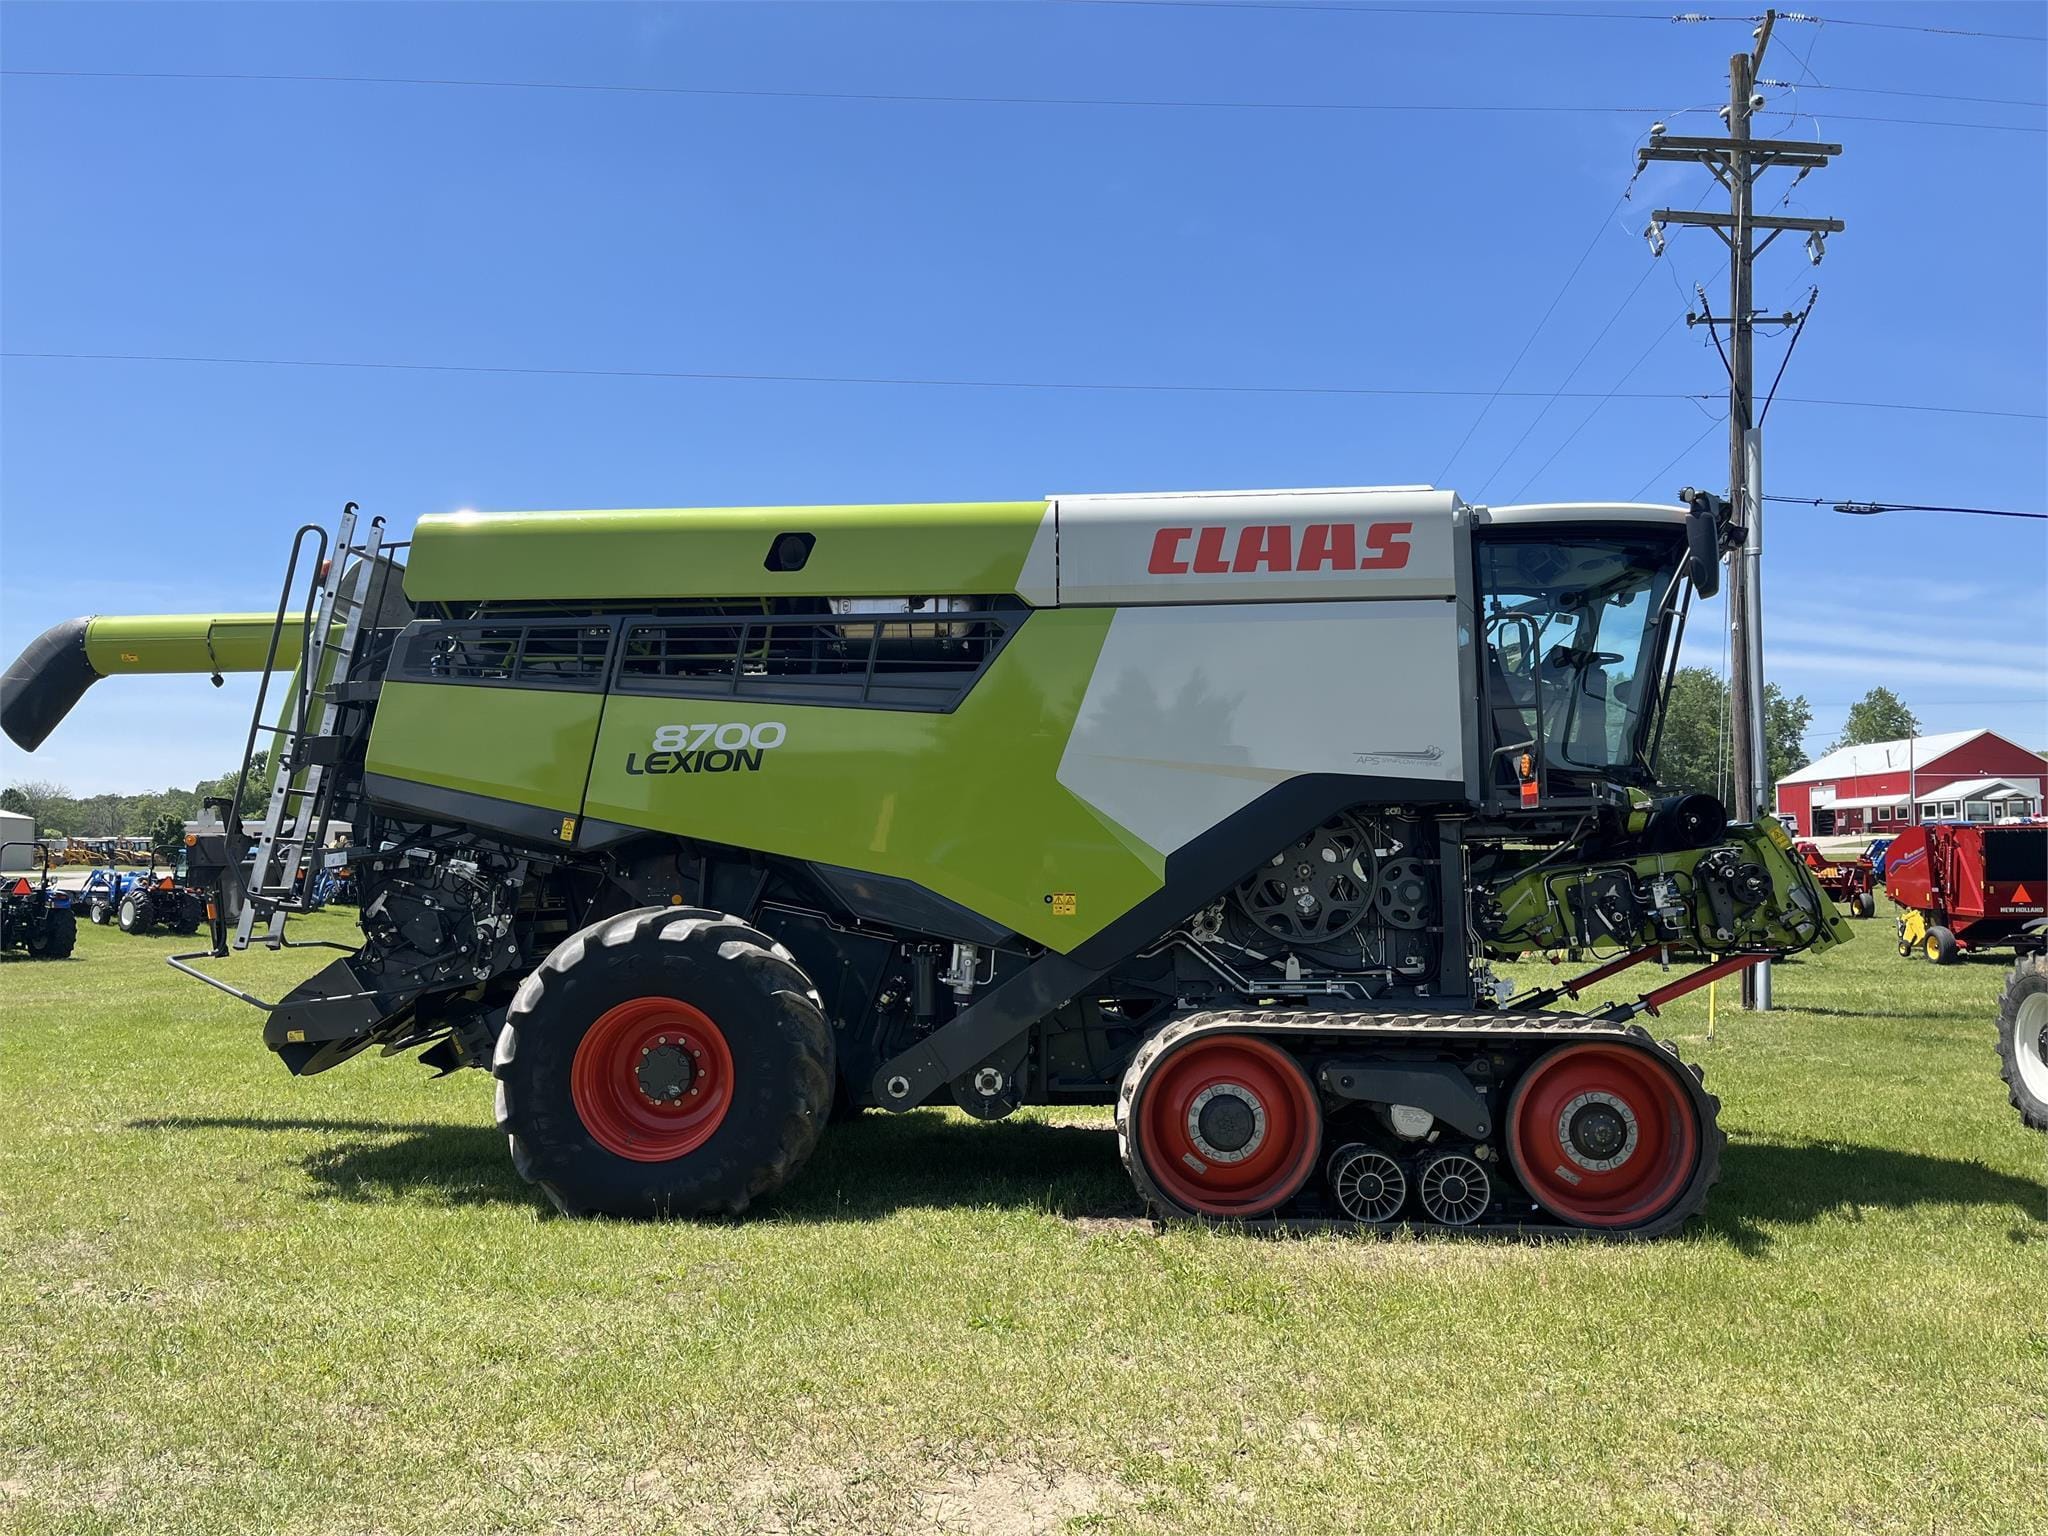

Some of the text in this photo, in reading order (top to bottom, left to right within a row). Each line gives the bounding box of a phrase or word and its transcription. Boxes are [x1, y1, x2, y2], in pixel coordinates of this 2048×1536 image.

[1148, 522, 1413, 574] CLAAS
[652, 721, 787, 752] 8700
[626, 749, 764, 775] LEXION
[1356, 755, 1380, 766] APS
